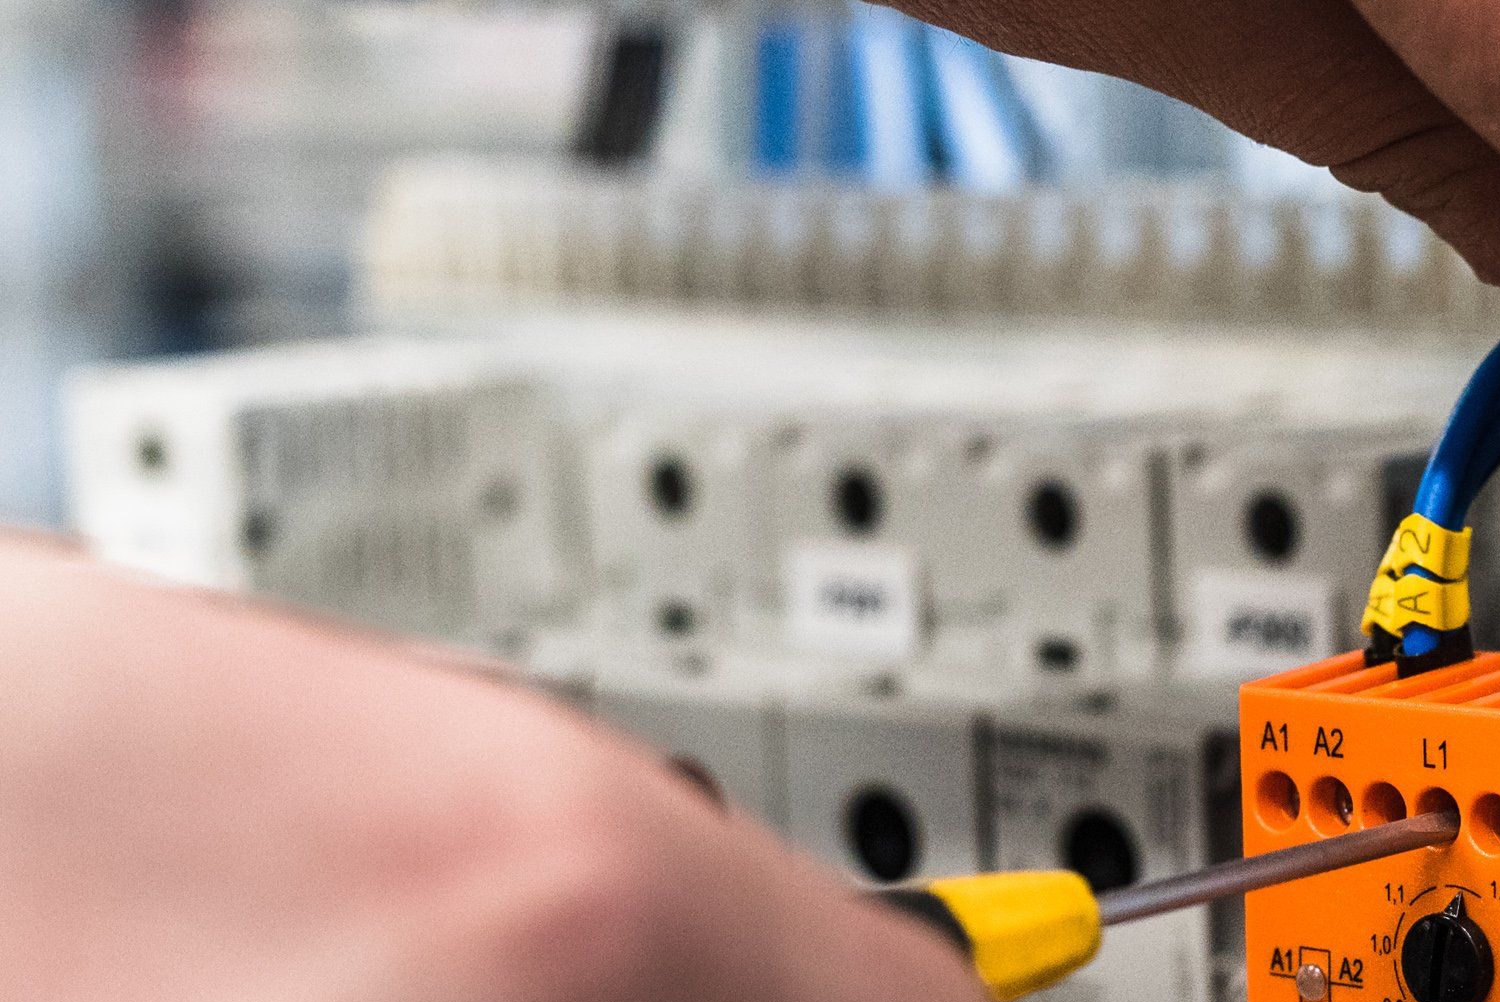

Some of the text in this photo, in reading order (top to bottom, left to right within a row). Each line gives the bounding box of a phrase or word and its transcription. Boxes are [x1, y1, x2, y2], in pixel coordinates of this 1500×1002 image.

[1260, 720, 1289, 753] A1
[1313, 726, 1344, 759] A2
[1422, 738, 1447, 770] L1
[1385, 882, 1405, 904] 1,1
[1370, 933, 1392, 956] 1,0
[1270, 947, 1293, 972] A1
[1338, 957, 1364, 982] A2
